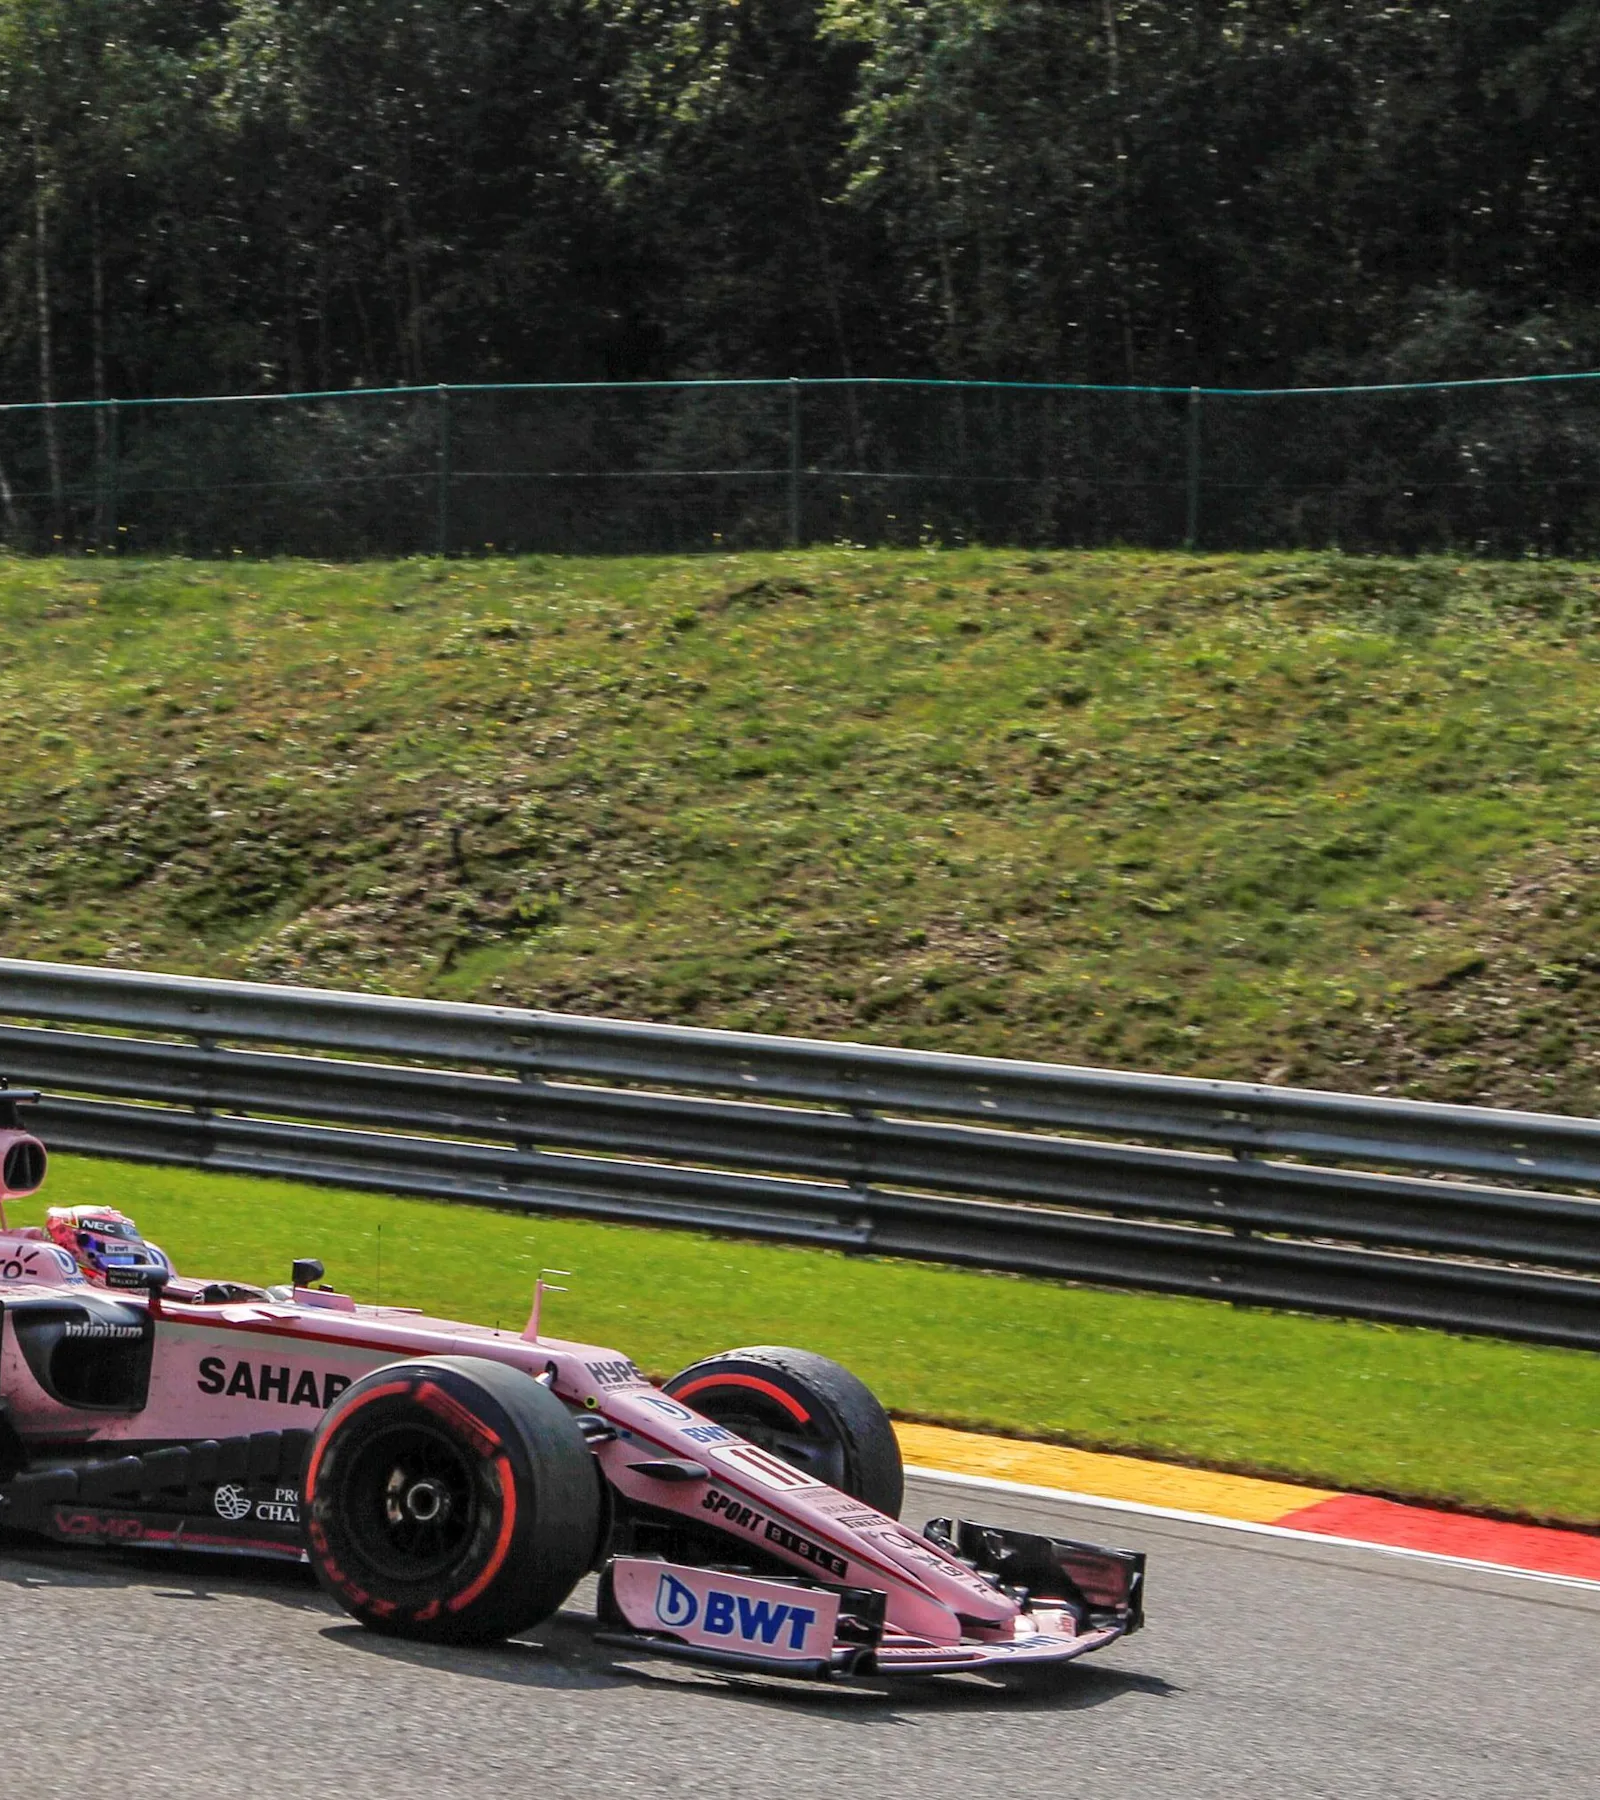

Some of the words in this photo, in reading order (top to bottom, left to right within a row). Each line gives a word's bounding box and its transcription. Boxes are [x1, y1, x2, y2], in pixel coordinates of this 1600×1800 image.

[82, 1219, 115, 1233] NEC
[64, 1321, 143, 1339] infinitum
[583, 1360, 646, 1385] HYPE
[679, 1425, 742, 1444] BWT
[729, 1448, 811, 1486] 11
[255, 1505, 300, 1523] CHA
[701, 1489, 764, 1531] SPORT
[769, 1526, 843, 1575] BIBLE
[703, 1590, 816, 1651] BWT
